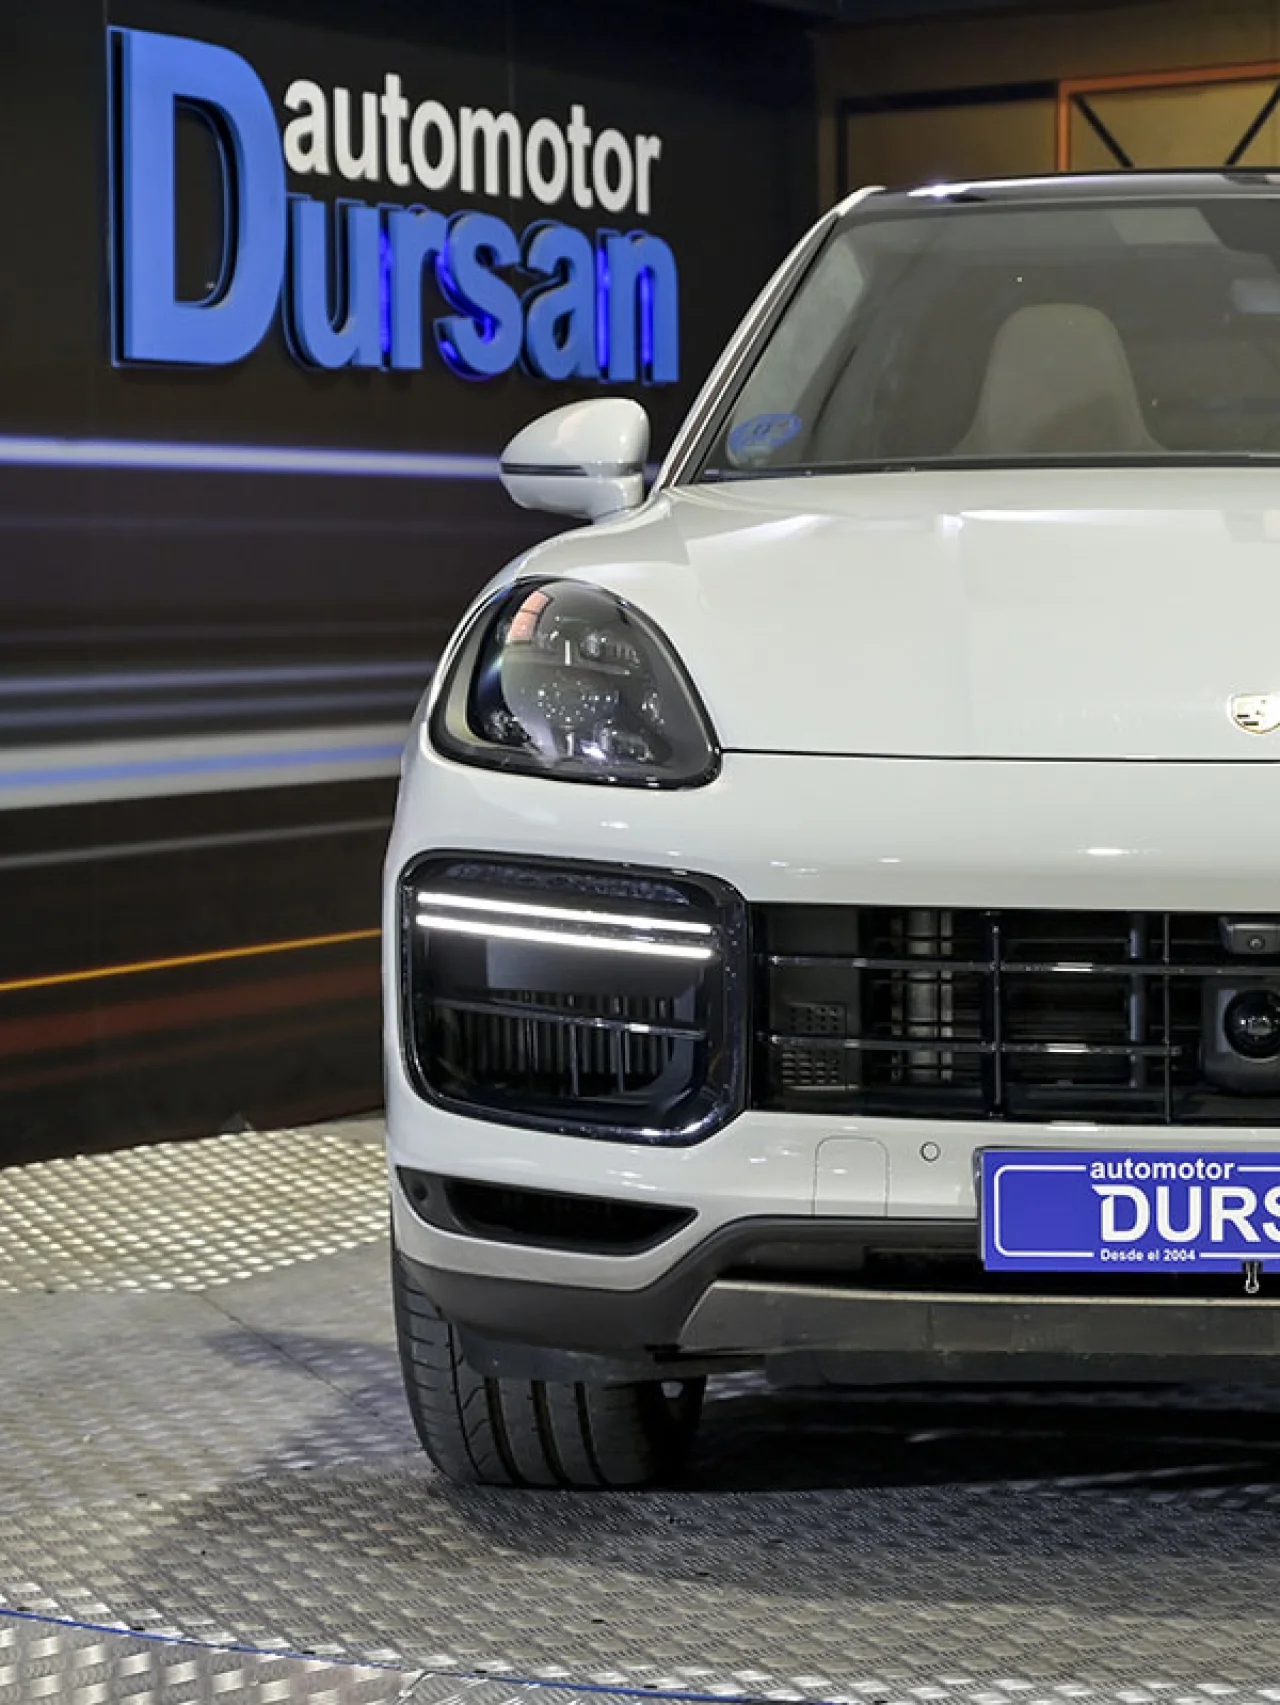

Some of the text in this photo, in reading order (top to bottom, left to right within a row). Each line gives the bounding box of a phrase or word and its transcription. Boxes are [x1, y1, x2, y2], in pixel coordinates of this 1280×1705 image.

[283, 73, 661, 214] automotor
[107, 25, 680, 384] Dursan
[1090, 1158, 1235, 1179] automotor
[1100, 1248, 1196, 1261] Desde el 2004
